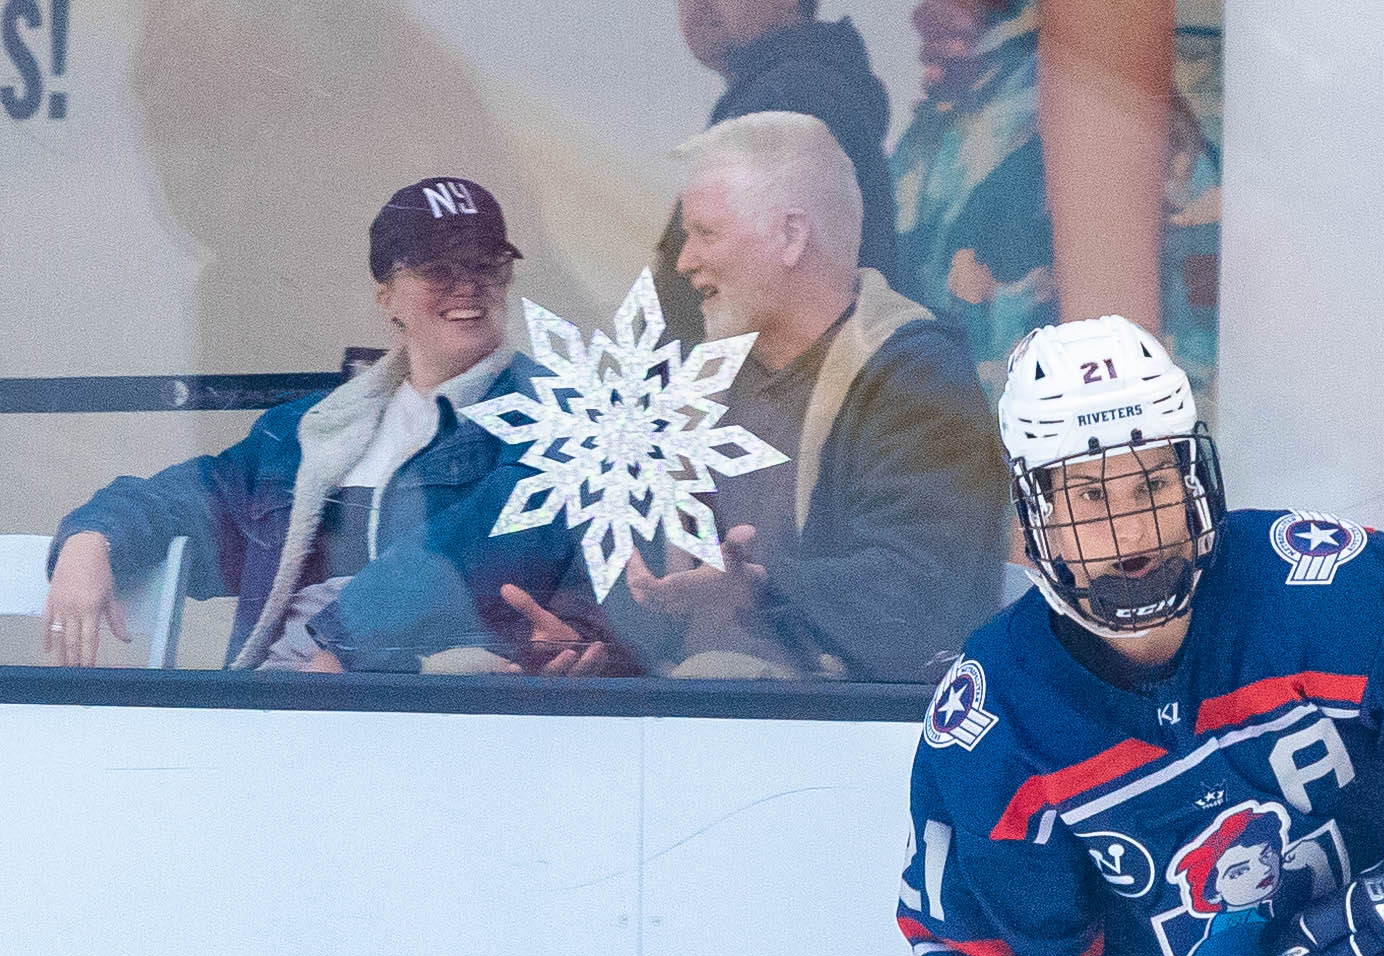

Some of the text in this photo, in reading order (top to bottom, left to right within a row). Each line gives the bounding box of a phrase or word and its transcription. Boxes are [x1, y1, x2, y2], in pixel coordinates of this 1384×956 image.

[1080, 359, 1117, 384] 21
[1077, 404, 1143, 427] RIVETERS
[1268, 717, 1356, 815] A
